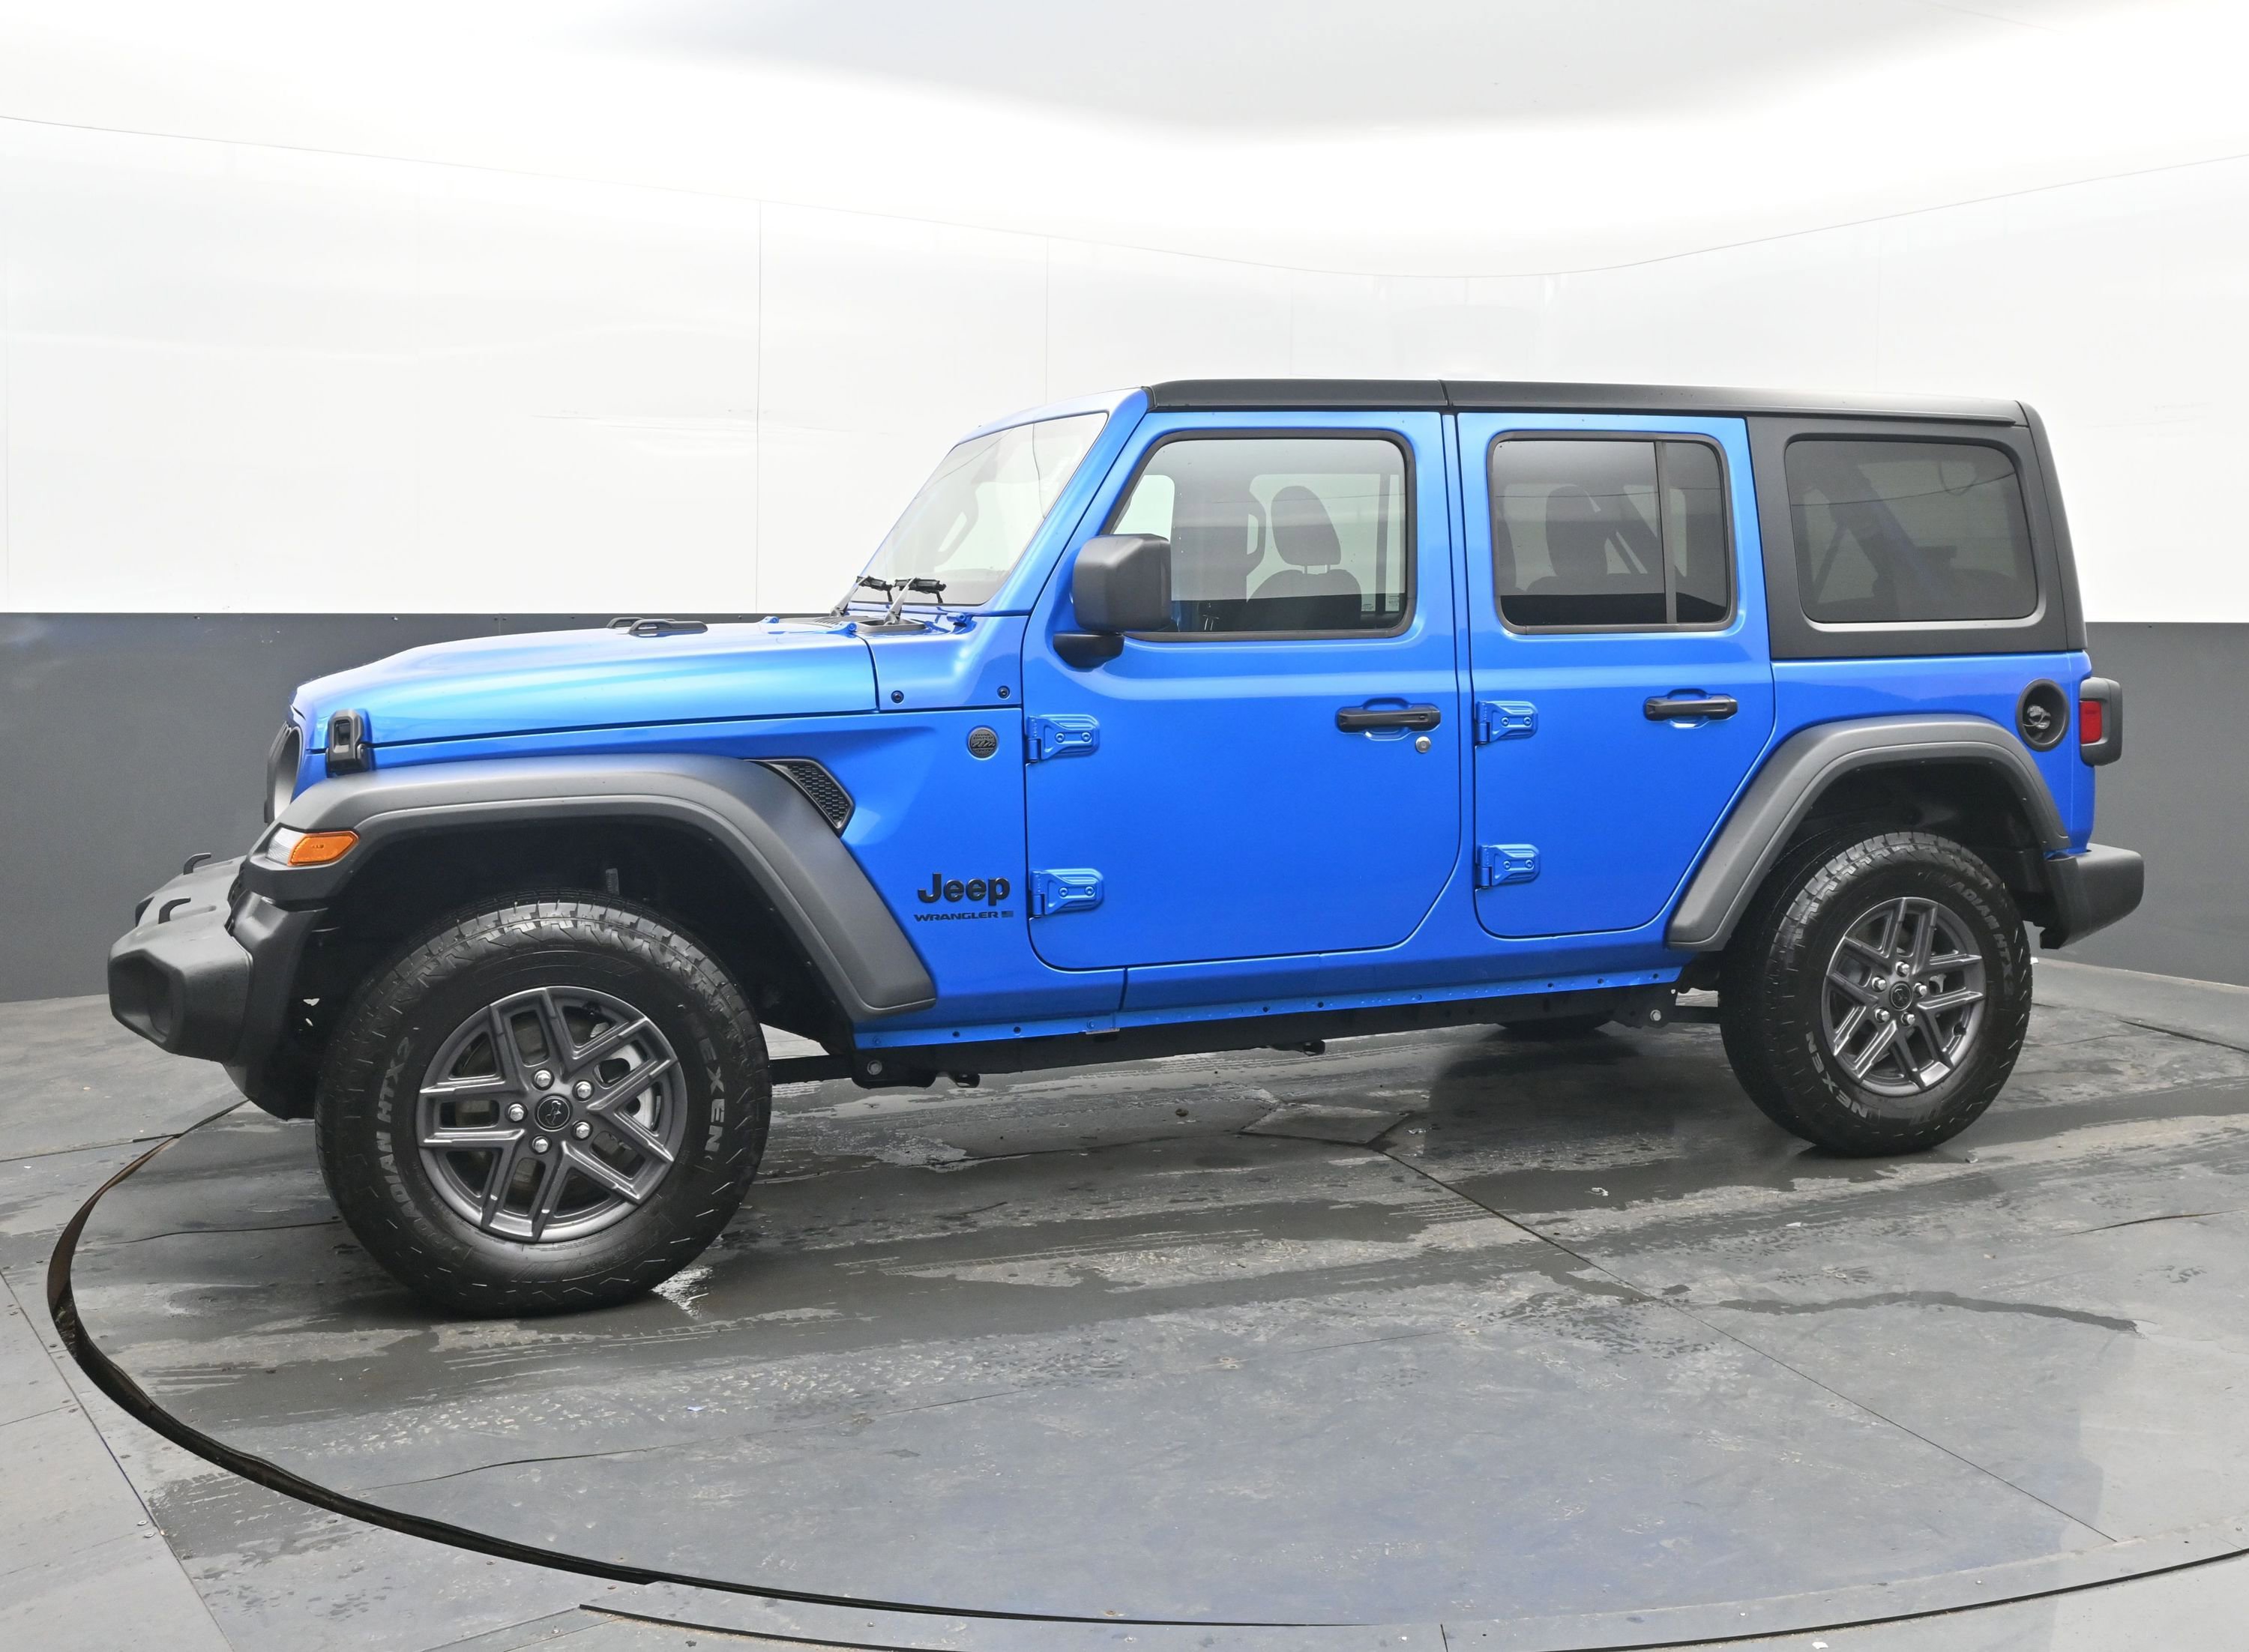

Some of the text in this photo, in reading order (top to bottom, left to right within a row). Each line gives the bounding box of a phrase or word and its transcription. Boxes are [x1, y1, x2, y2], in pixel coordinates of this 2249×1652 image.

[914, 911, 999, 922] WRANGLER
[917, 872, 1011, 906] Jeep
[690, 1019, 725, 1152] EXEN
[1804, 1031, 1868, 1118] NEXEN
